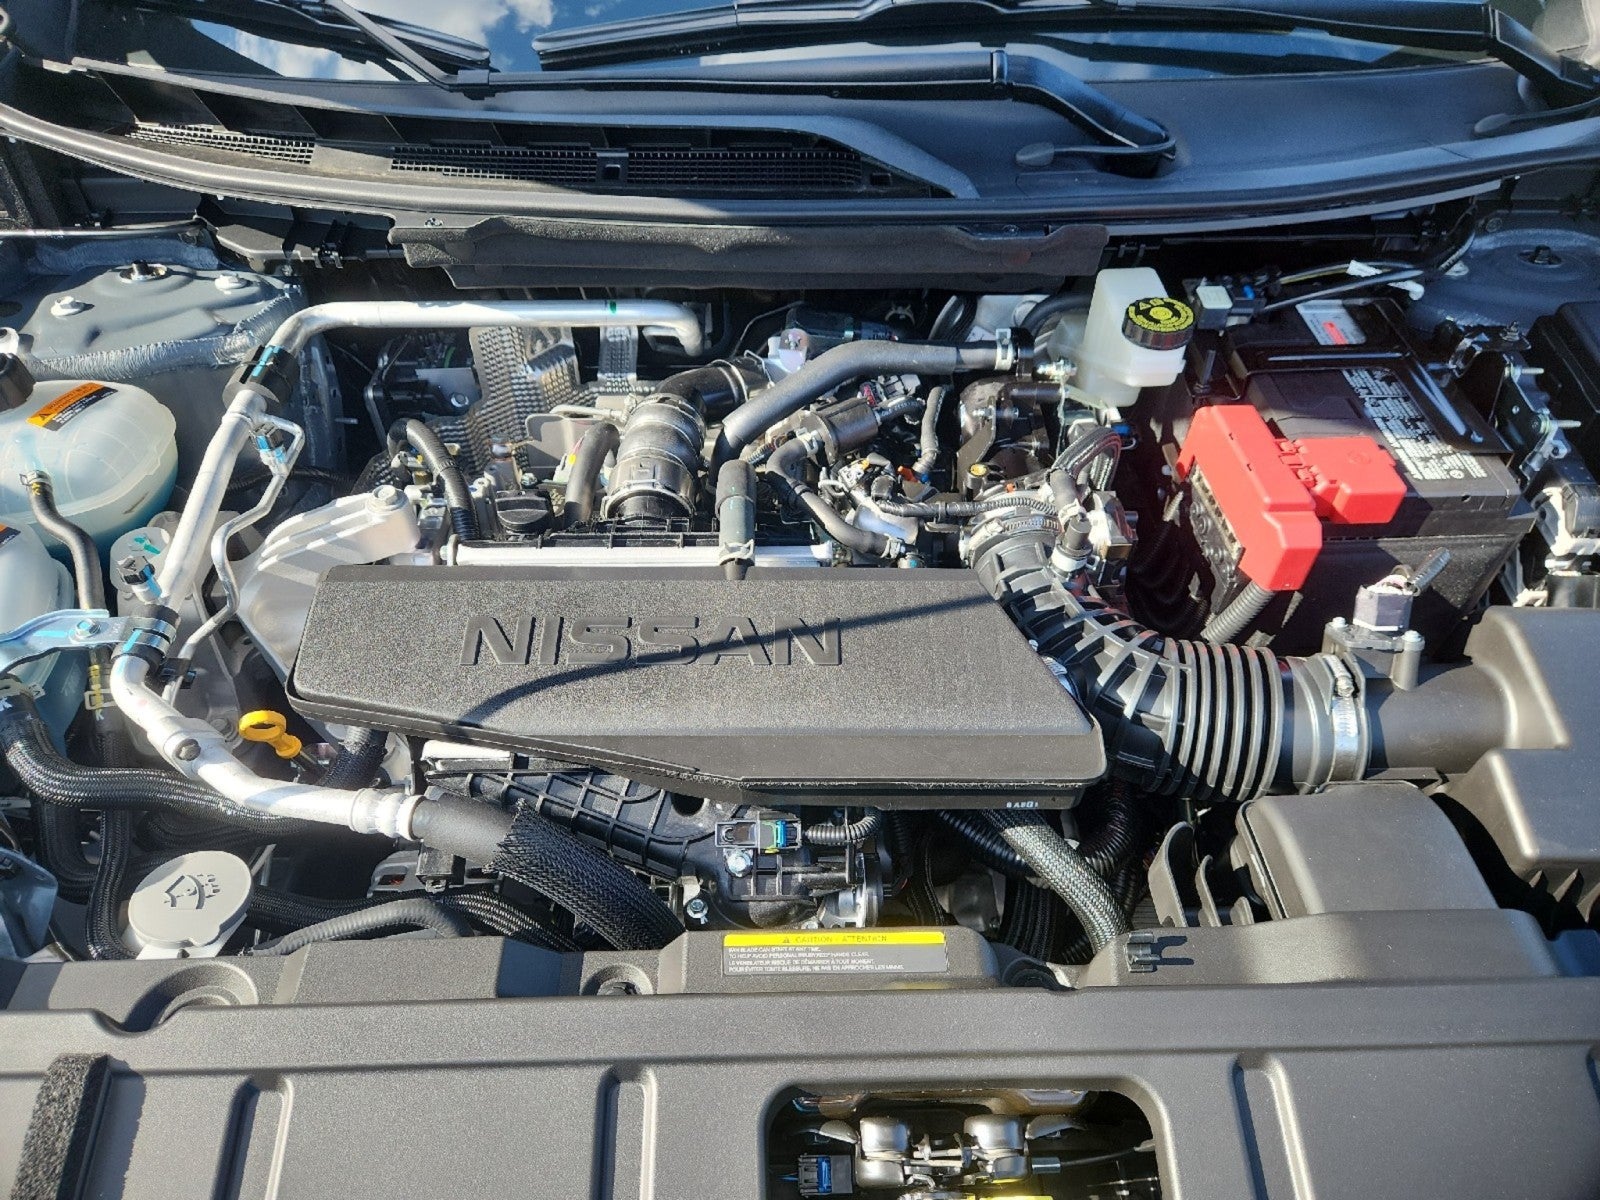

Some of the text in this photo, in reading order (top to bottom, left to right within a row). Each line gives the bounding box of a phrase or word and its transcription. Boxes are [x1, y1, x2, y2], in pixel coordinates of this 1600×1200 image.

[459, 616, 842, 665] NISSAN
[795, 935, 887, 944] CAUTION ATTENTION
